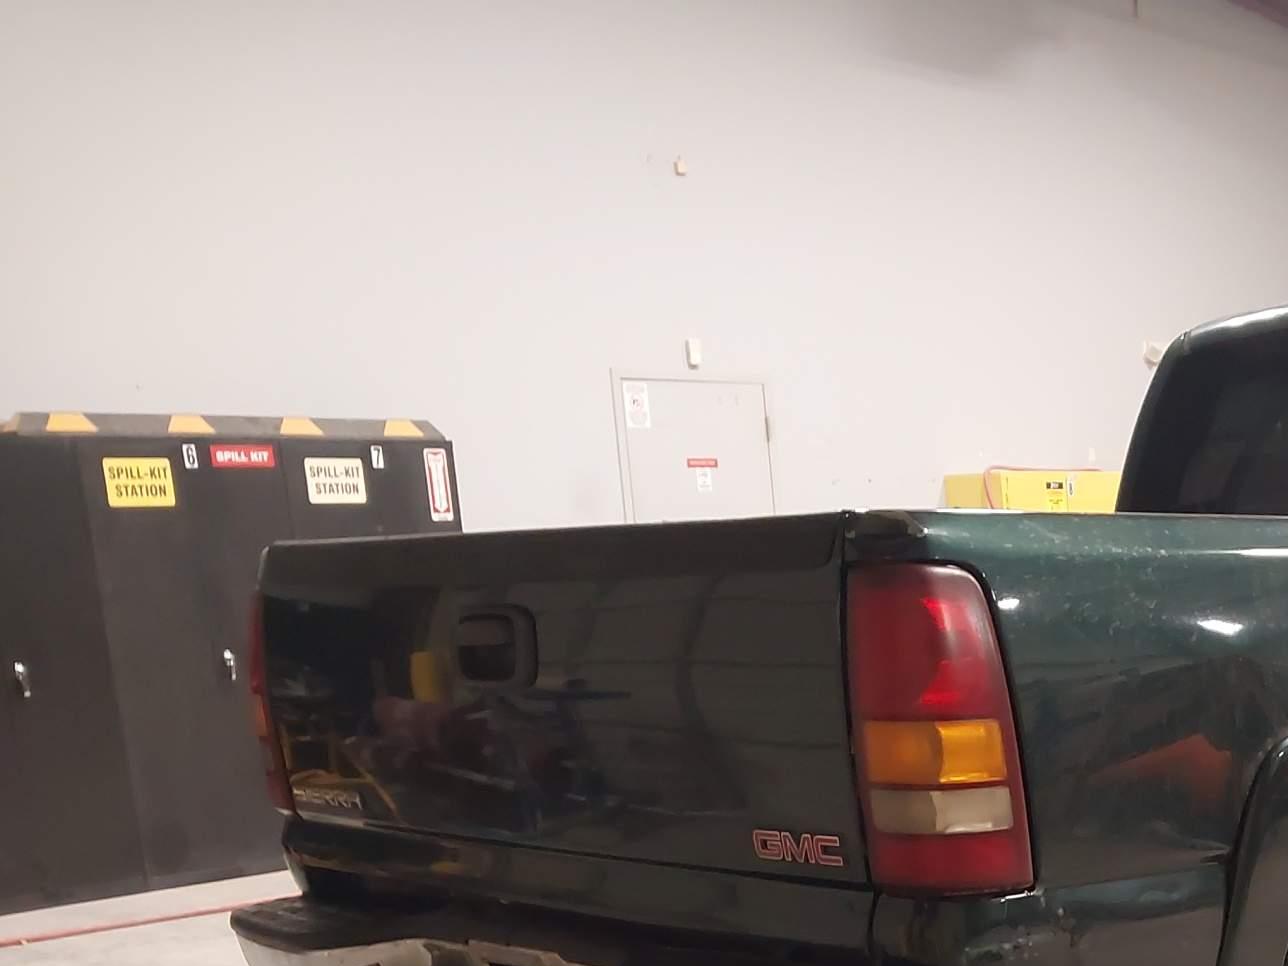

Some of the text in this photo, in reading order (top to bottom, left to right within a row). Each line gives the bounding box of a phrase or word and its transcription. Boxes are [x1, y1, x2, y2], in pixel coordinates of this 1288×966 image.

[186, 446, 196, 466] 6
[215, 449, 269, 463] SPILL KIT
[373, 446, 381, 467] 7
[108, 466, 168, 480] SPILL-KIT
[309, 465, 360, 479] SPILL-KIT
[115, 484, 167, 498] STATION
[315, 482, 360, 496] STATION
[752, 829, 844, 867] GMC
